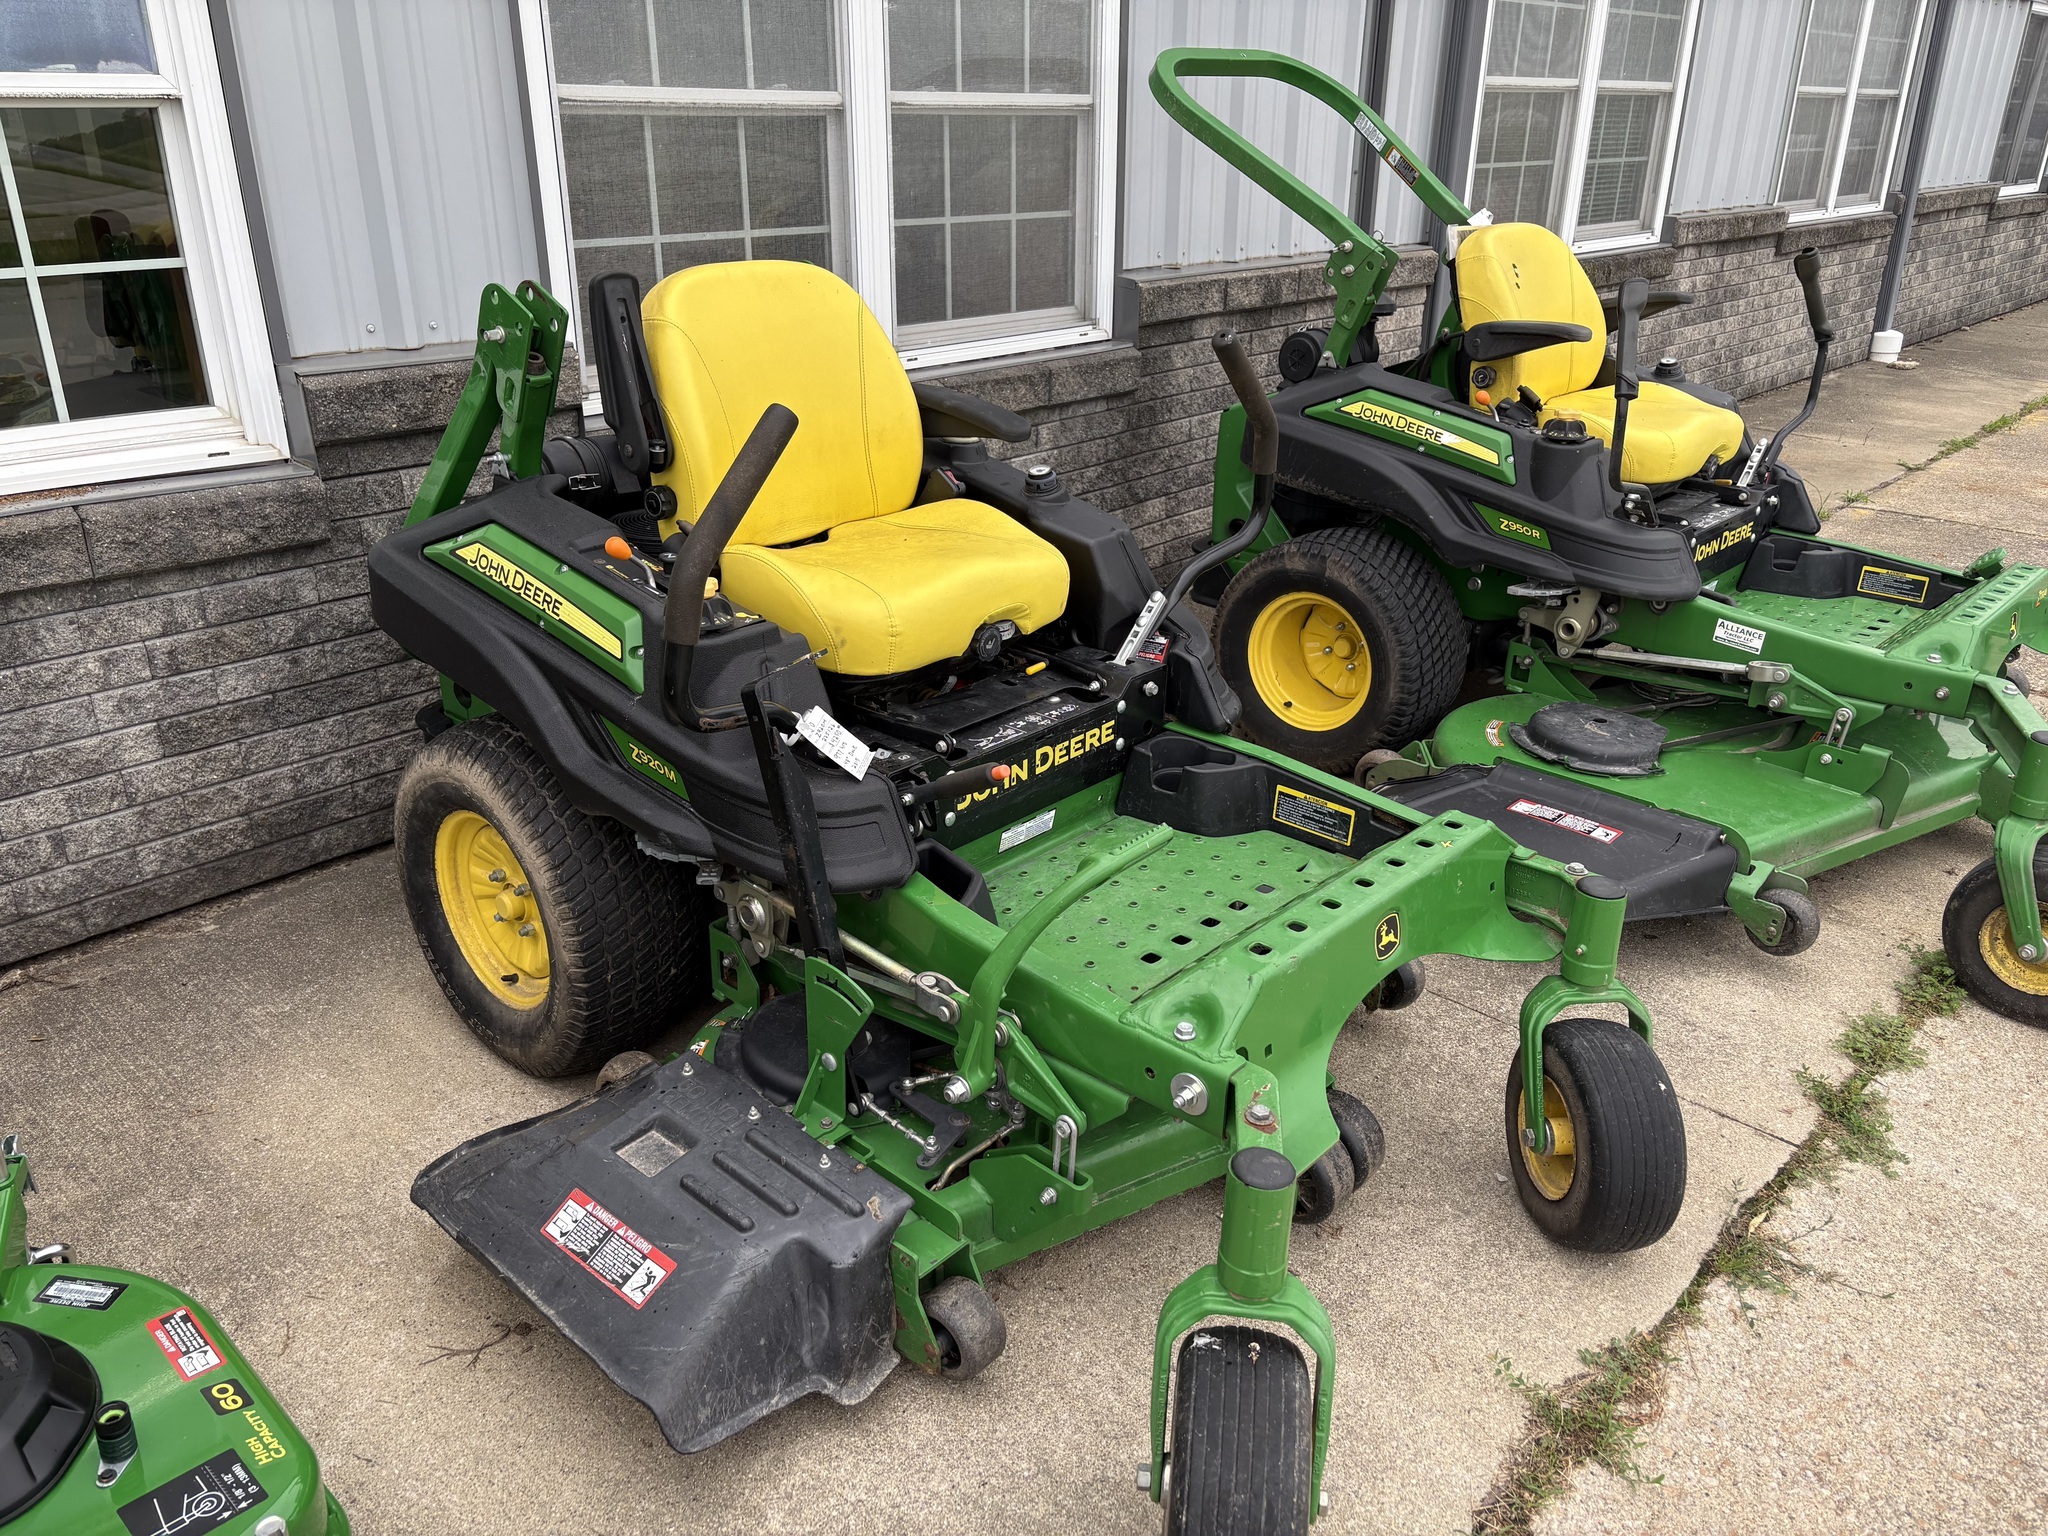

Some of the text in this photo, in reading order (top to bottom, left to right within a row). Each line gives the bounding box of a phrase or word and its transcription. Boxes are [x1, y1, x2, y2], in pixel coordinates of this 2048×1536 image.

[1354, 403, 1444, 443] JOHN DEERE
[1499, 517, 1541, 540] Z950R
[1693, 521, 1755, 563] JOHN DEERE
[468, 547, 564, 618] JOHN DEERE
[1717, 620, 1764, 641] ALLIANCE
[1723, 630, 1744, 640] Tractor
[628, 742, 677, 784] Z920M
[1035, 720, 1116, 775] DEERE
[418, 932, 466, 1014] MASTER
[591, 1204, 619, 1228] DANGER
[623, 1229, 653, 1254] PELIGRO
[154, 1328, 173, 1349] DANGER
[211, 1383, 244, 1410] 60
[242, 1409, 287, 1459] CAPACITY
[245, 1436, 273, 1466] HIGH
